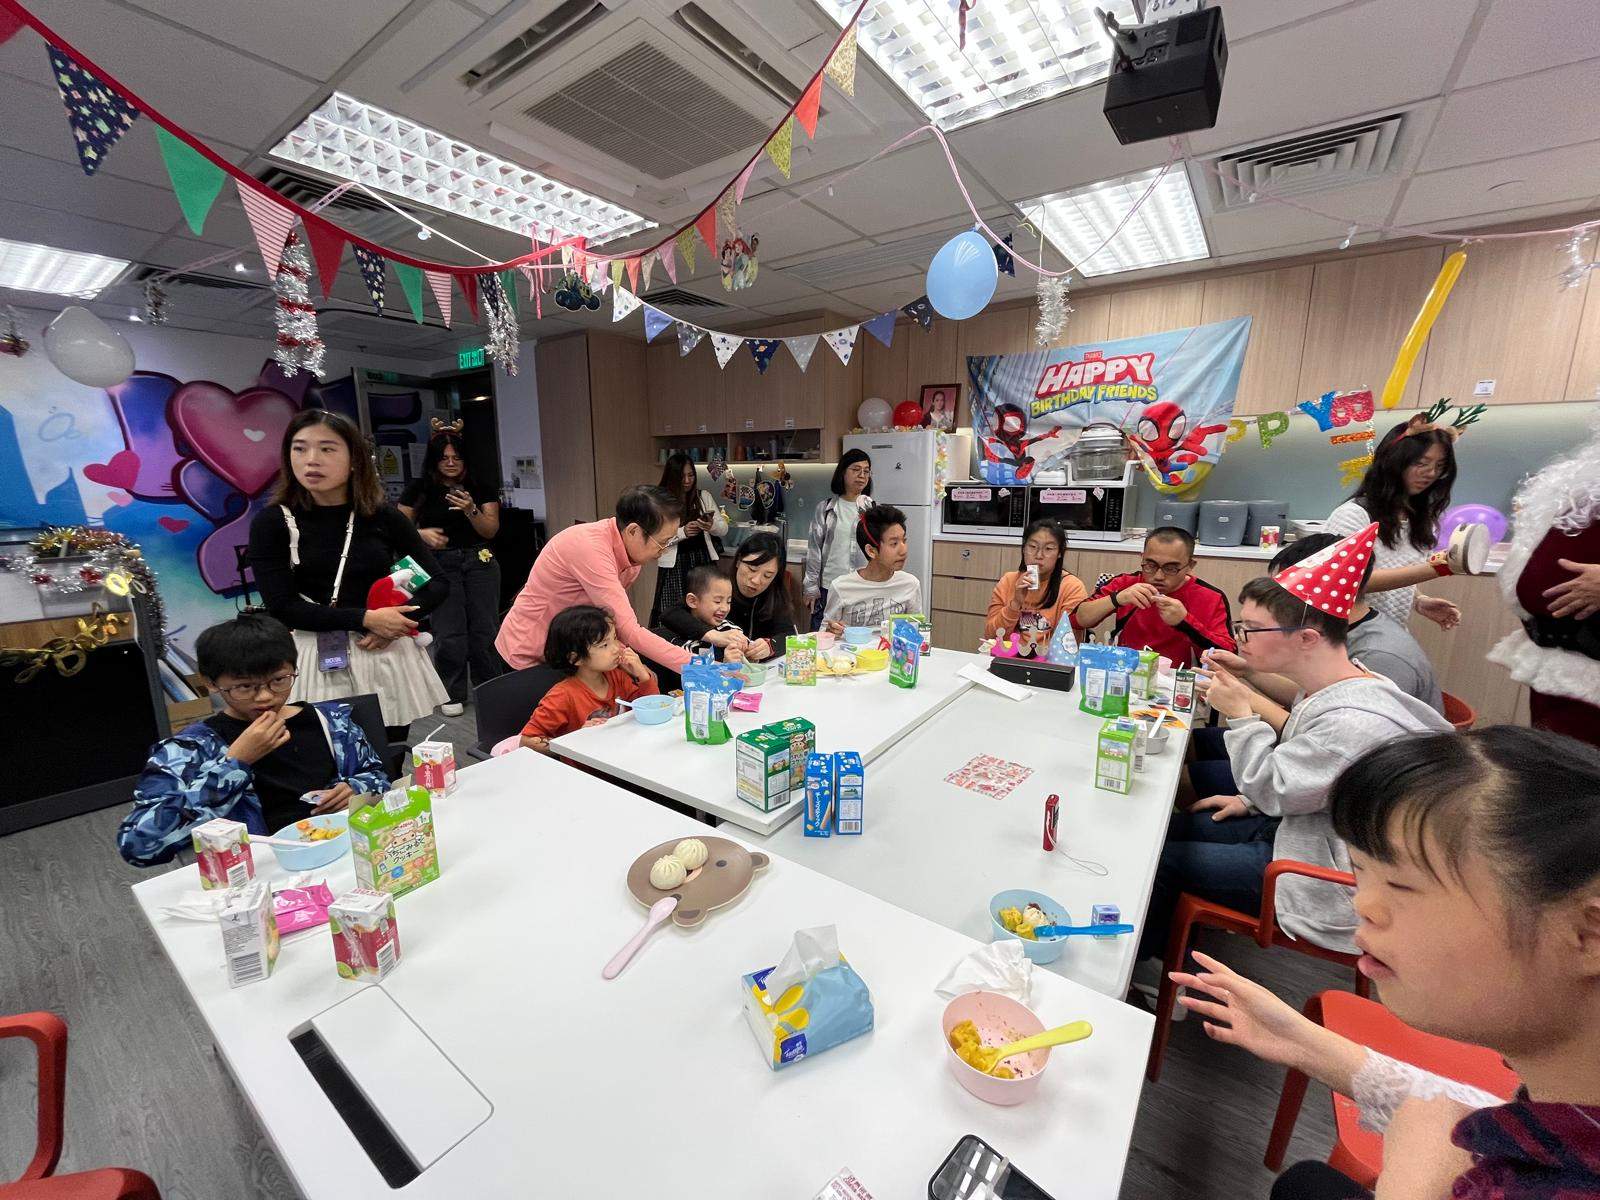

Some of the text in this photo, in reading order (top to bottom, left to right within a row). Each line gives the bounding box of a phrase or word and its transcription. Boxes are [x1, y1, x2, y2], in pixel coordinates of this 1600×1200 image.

[459, 352, 471, 369] EXIT
[1036, 353, 1153, 397] HAPPY
[1030, 383, 1158, 417] BIRTHDAY FRIENDS
